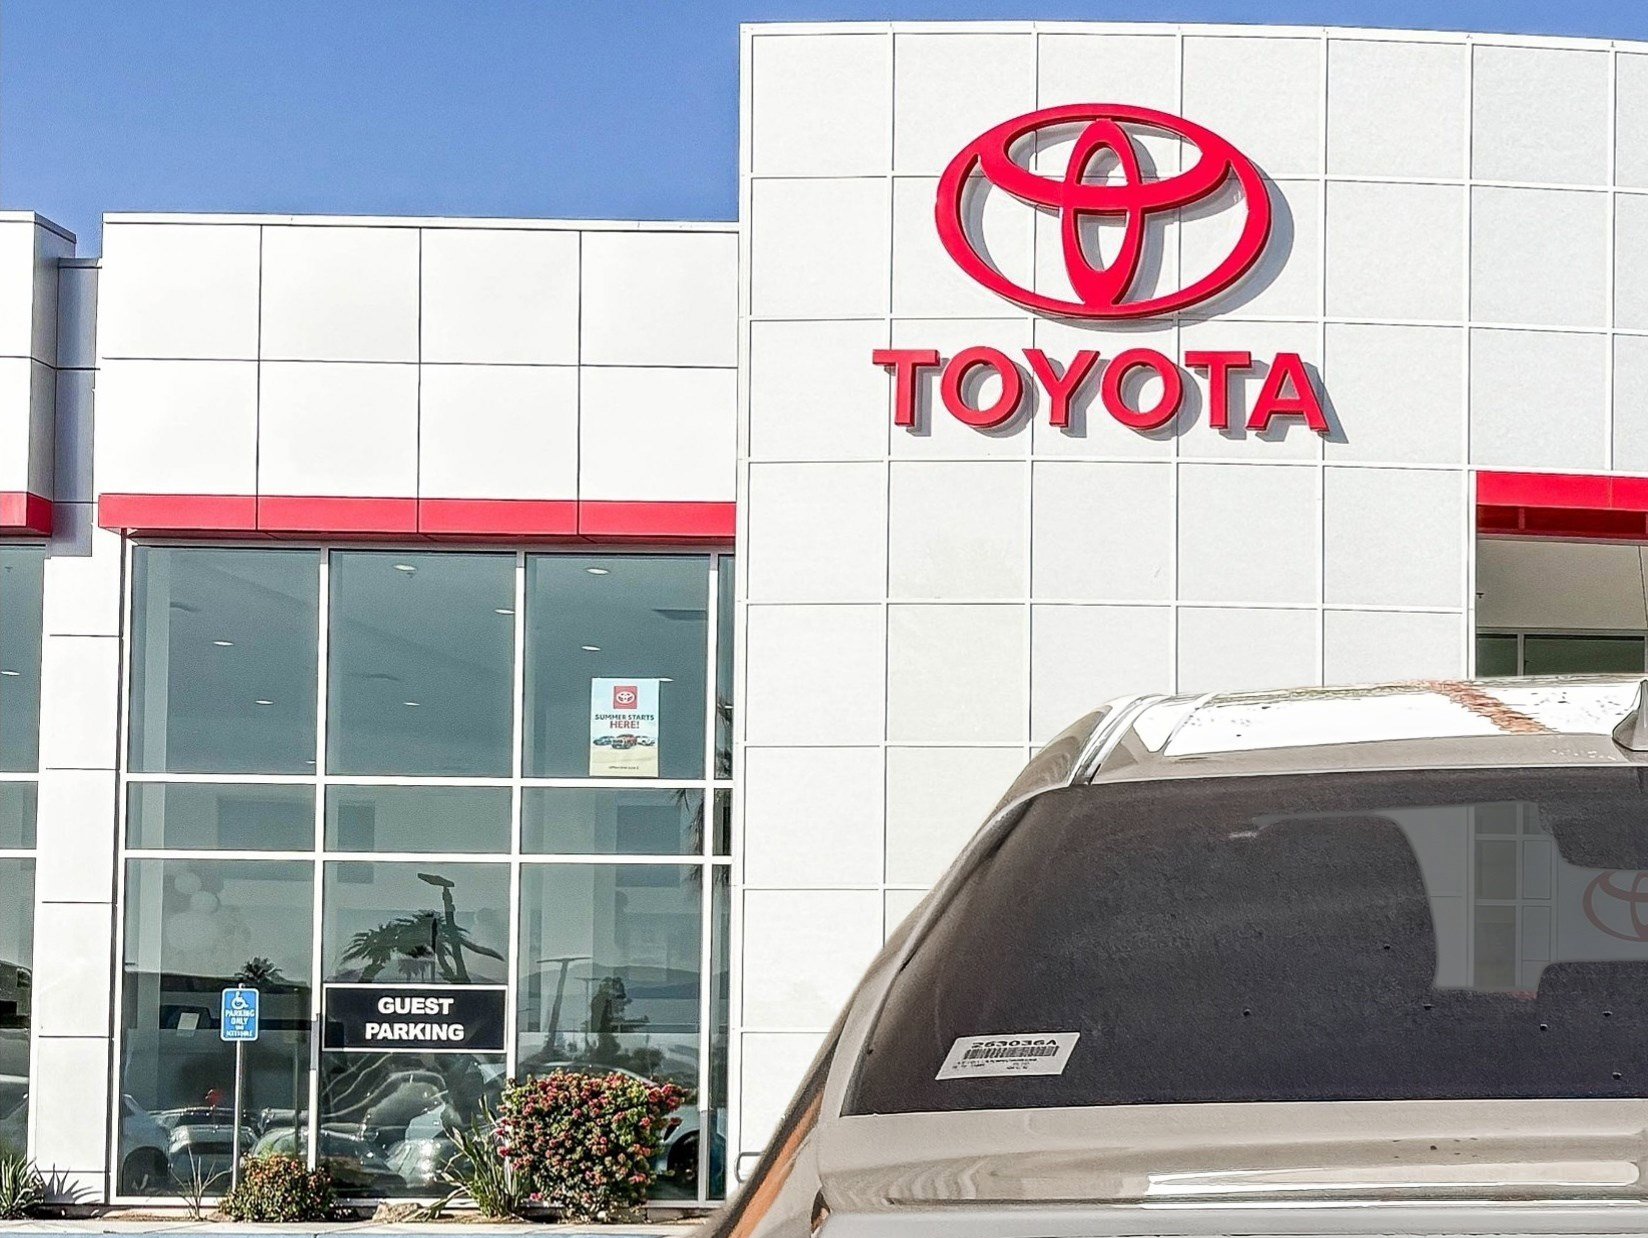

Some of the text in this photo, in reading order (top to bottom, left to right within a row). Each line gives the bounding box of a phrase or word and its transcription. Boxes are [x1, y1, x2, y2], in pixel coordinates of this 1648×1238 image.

[872, 346, 1329, 432] TOYOTA
[609, 720, 640, 729] HERE!
[377, 997, 454, 1015] GUEST
[225, 1009, 255, 1017] PARKING
[230, 1017, 249, 1025] ONLY
[365, 1022, 464, 1041] PARKING
